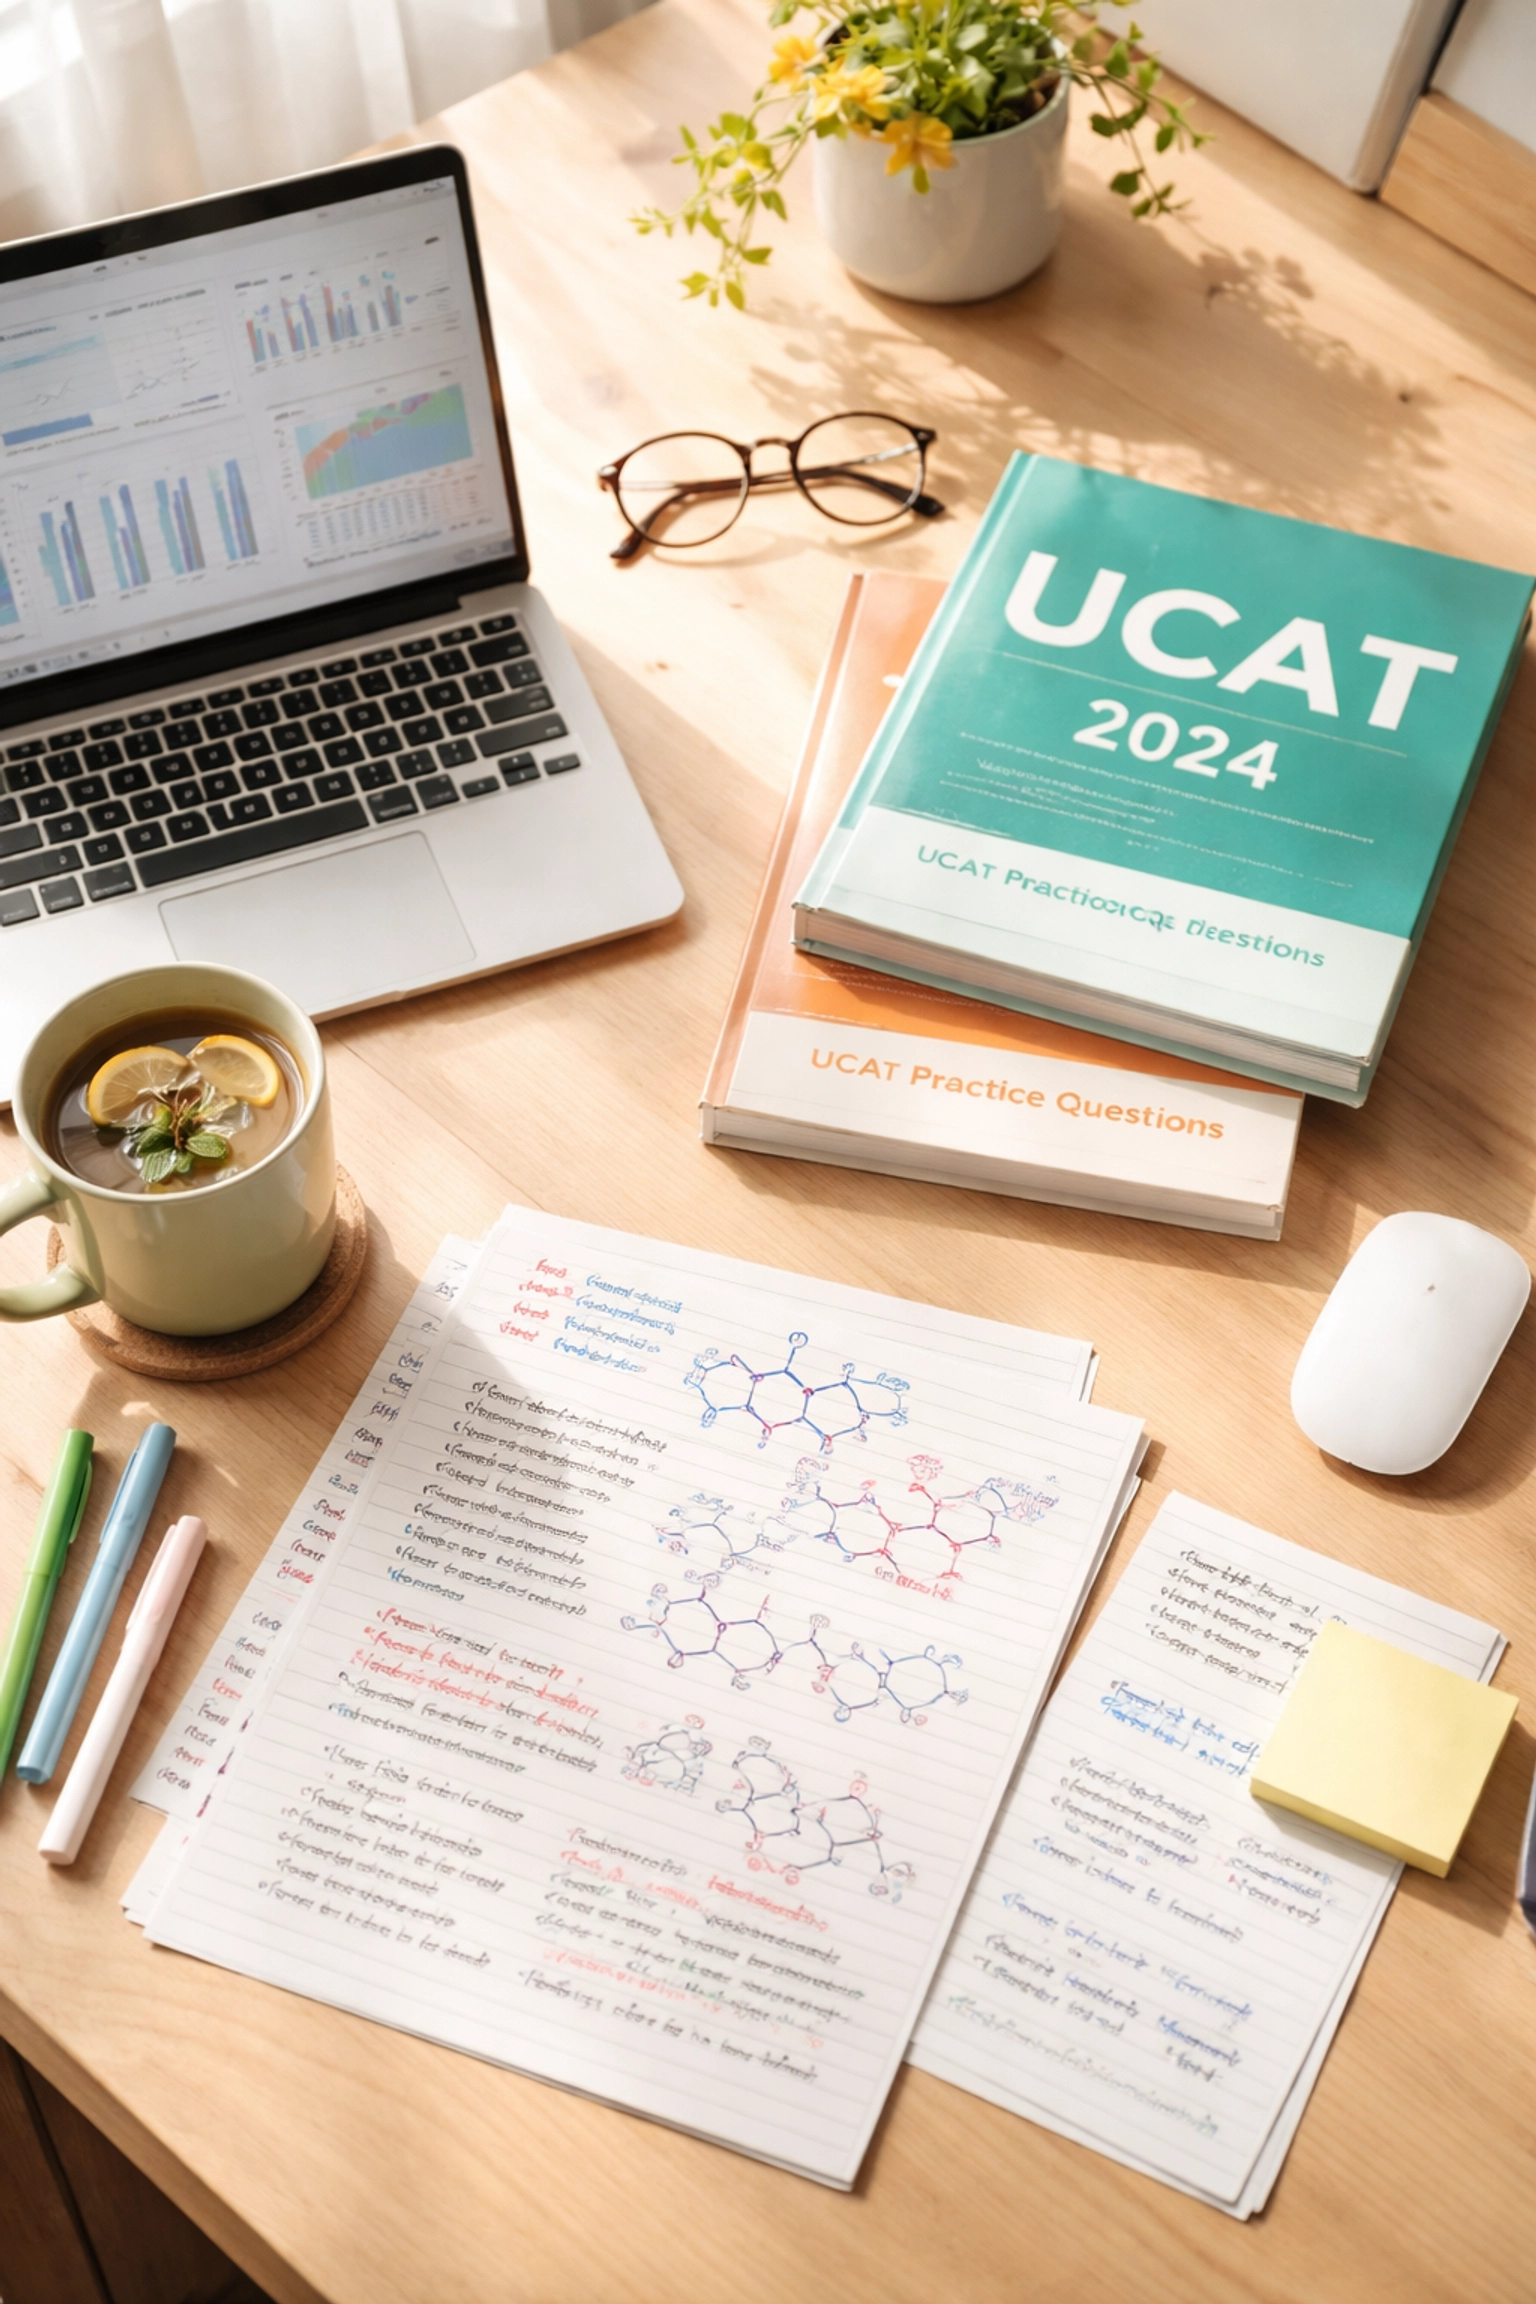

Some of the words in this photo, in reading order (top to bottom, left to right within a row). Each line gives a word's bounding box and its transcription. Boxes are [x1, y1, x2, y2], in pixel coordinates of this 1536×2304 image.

[1004, 550, 1459, 731] UCAT
[1072, 699, 1279, 790] 2024
[917, 845, 997, 880] UCAT
[810, 1048, 901, 1082] UCAT
[909, 1064, 1046, 1109] Practice
[1055, 1090, 1225, 1140] Questions
